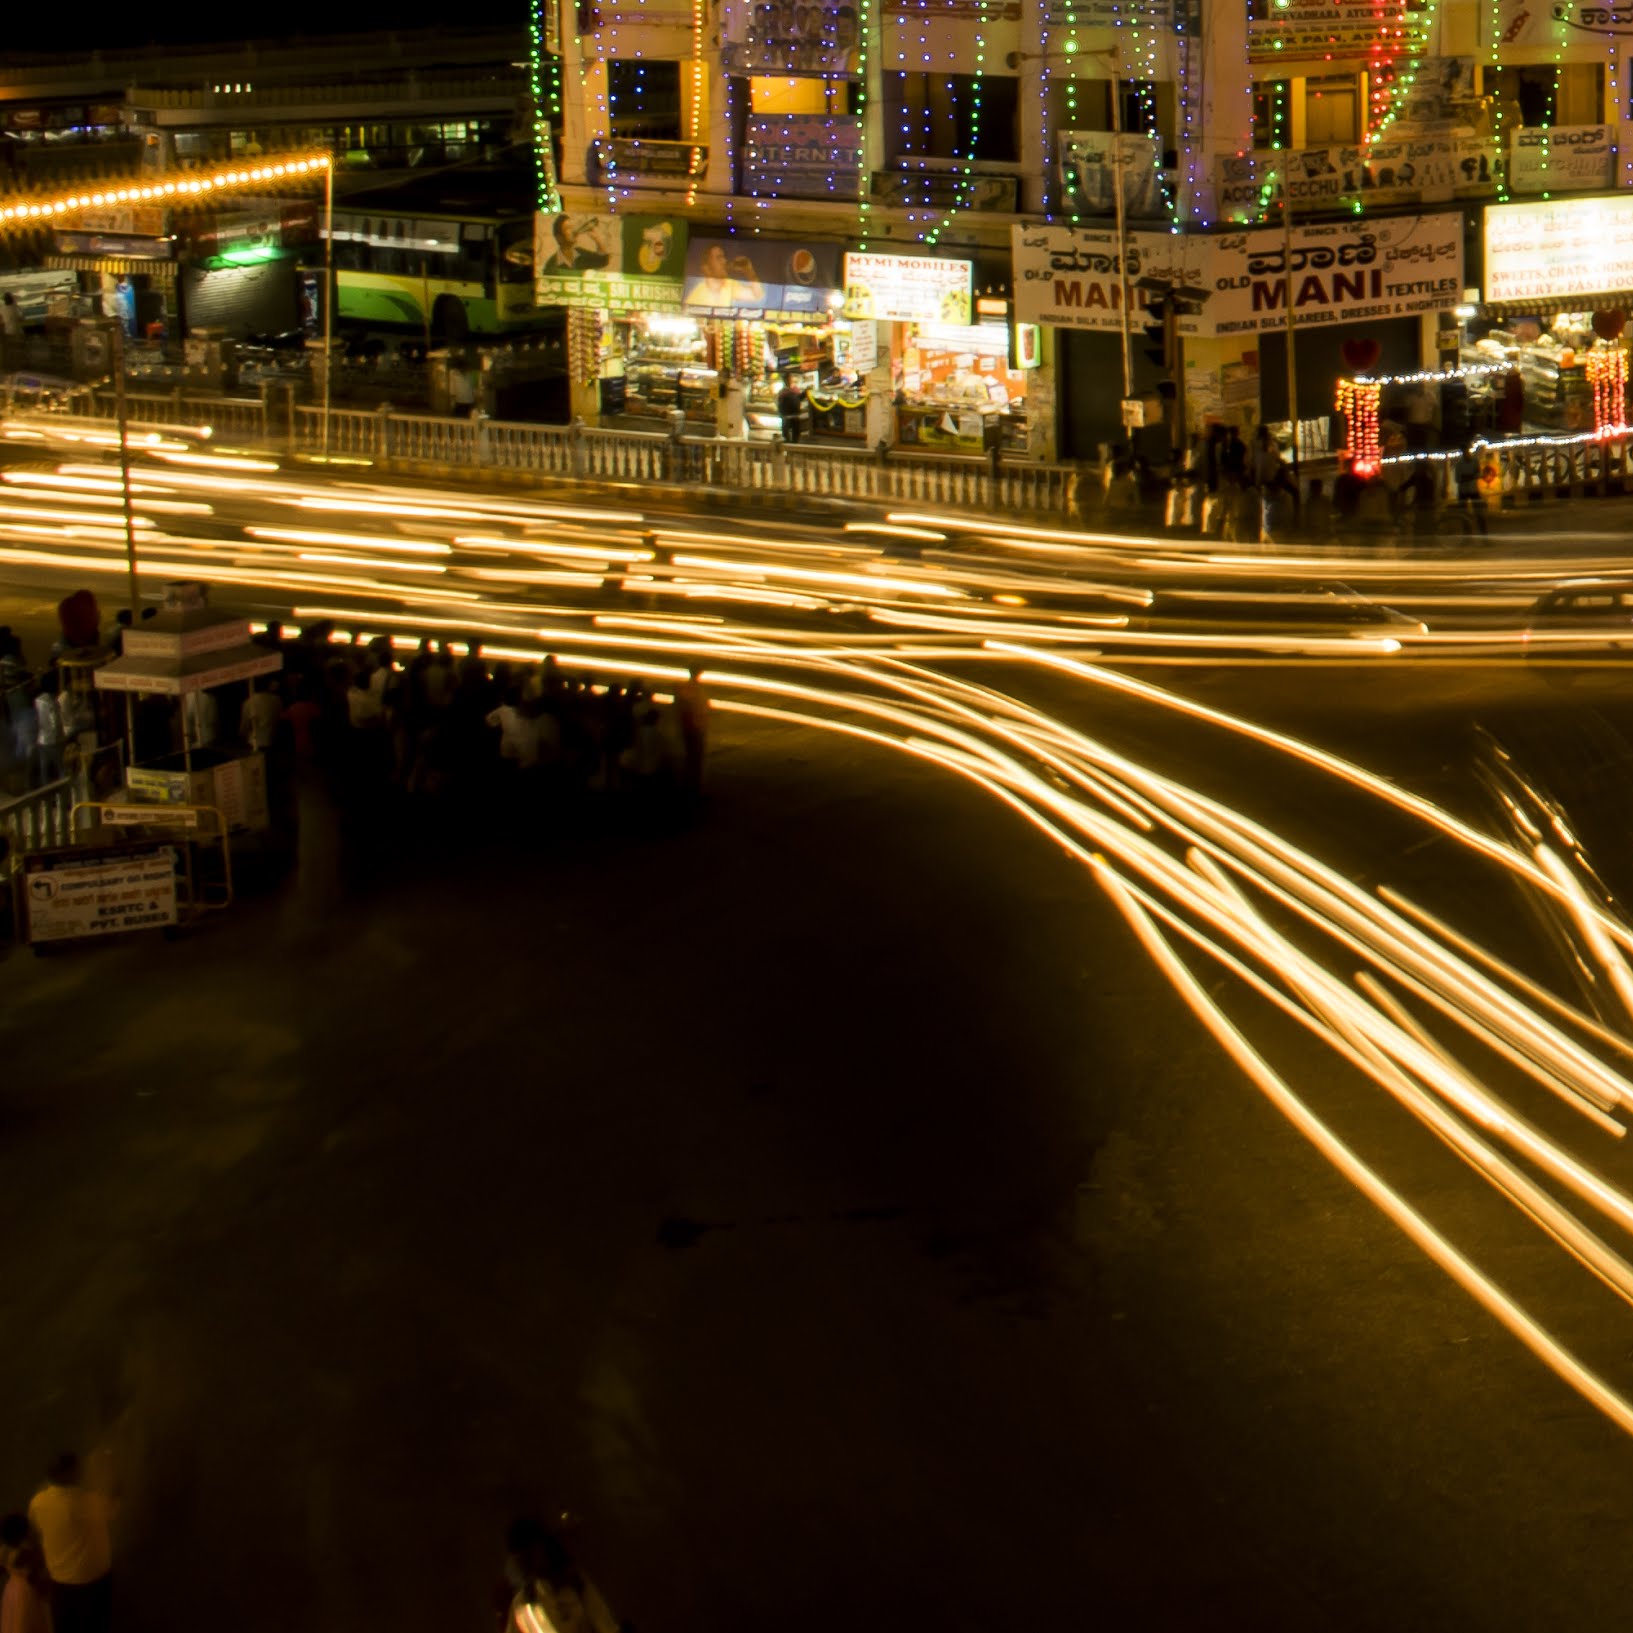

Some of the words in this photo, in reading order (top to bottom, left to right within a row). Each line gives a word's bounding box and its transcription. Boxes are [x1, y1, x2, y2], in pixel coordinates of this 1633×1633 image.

[1247, 232, 1377, 275] ಮಾಣಿ
[849, 255, 893, 267] MYMI
[897, 257, 969, 273] MOBILES
[1024, 269, 1054, 281] OLD
[1492, 270, 1546, 283] SWEETS,
[1216, 276, 1251, 291] OLD
[1252, 268, 1383, 312] MANI
[1386, 277, 1458, 298] TEXTILES
[1492, 282, 1552, 298] BAKERY
[1567, 280, 1602, 292] FAST
[1216, 320, 1258, 334] INDIAN
[1261, 315, 1286, 329] SILK
[1341, 304, 1392, 320] DRESSES
[1395, 303, 1402, 313] &
[1406, 296, 1457, 312] NIGHTIES
